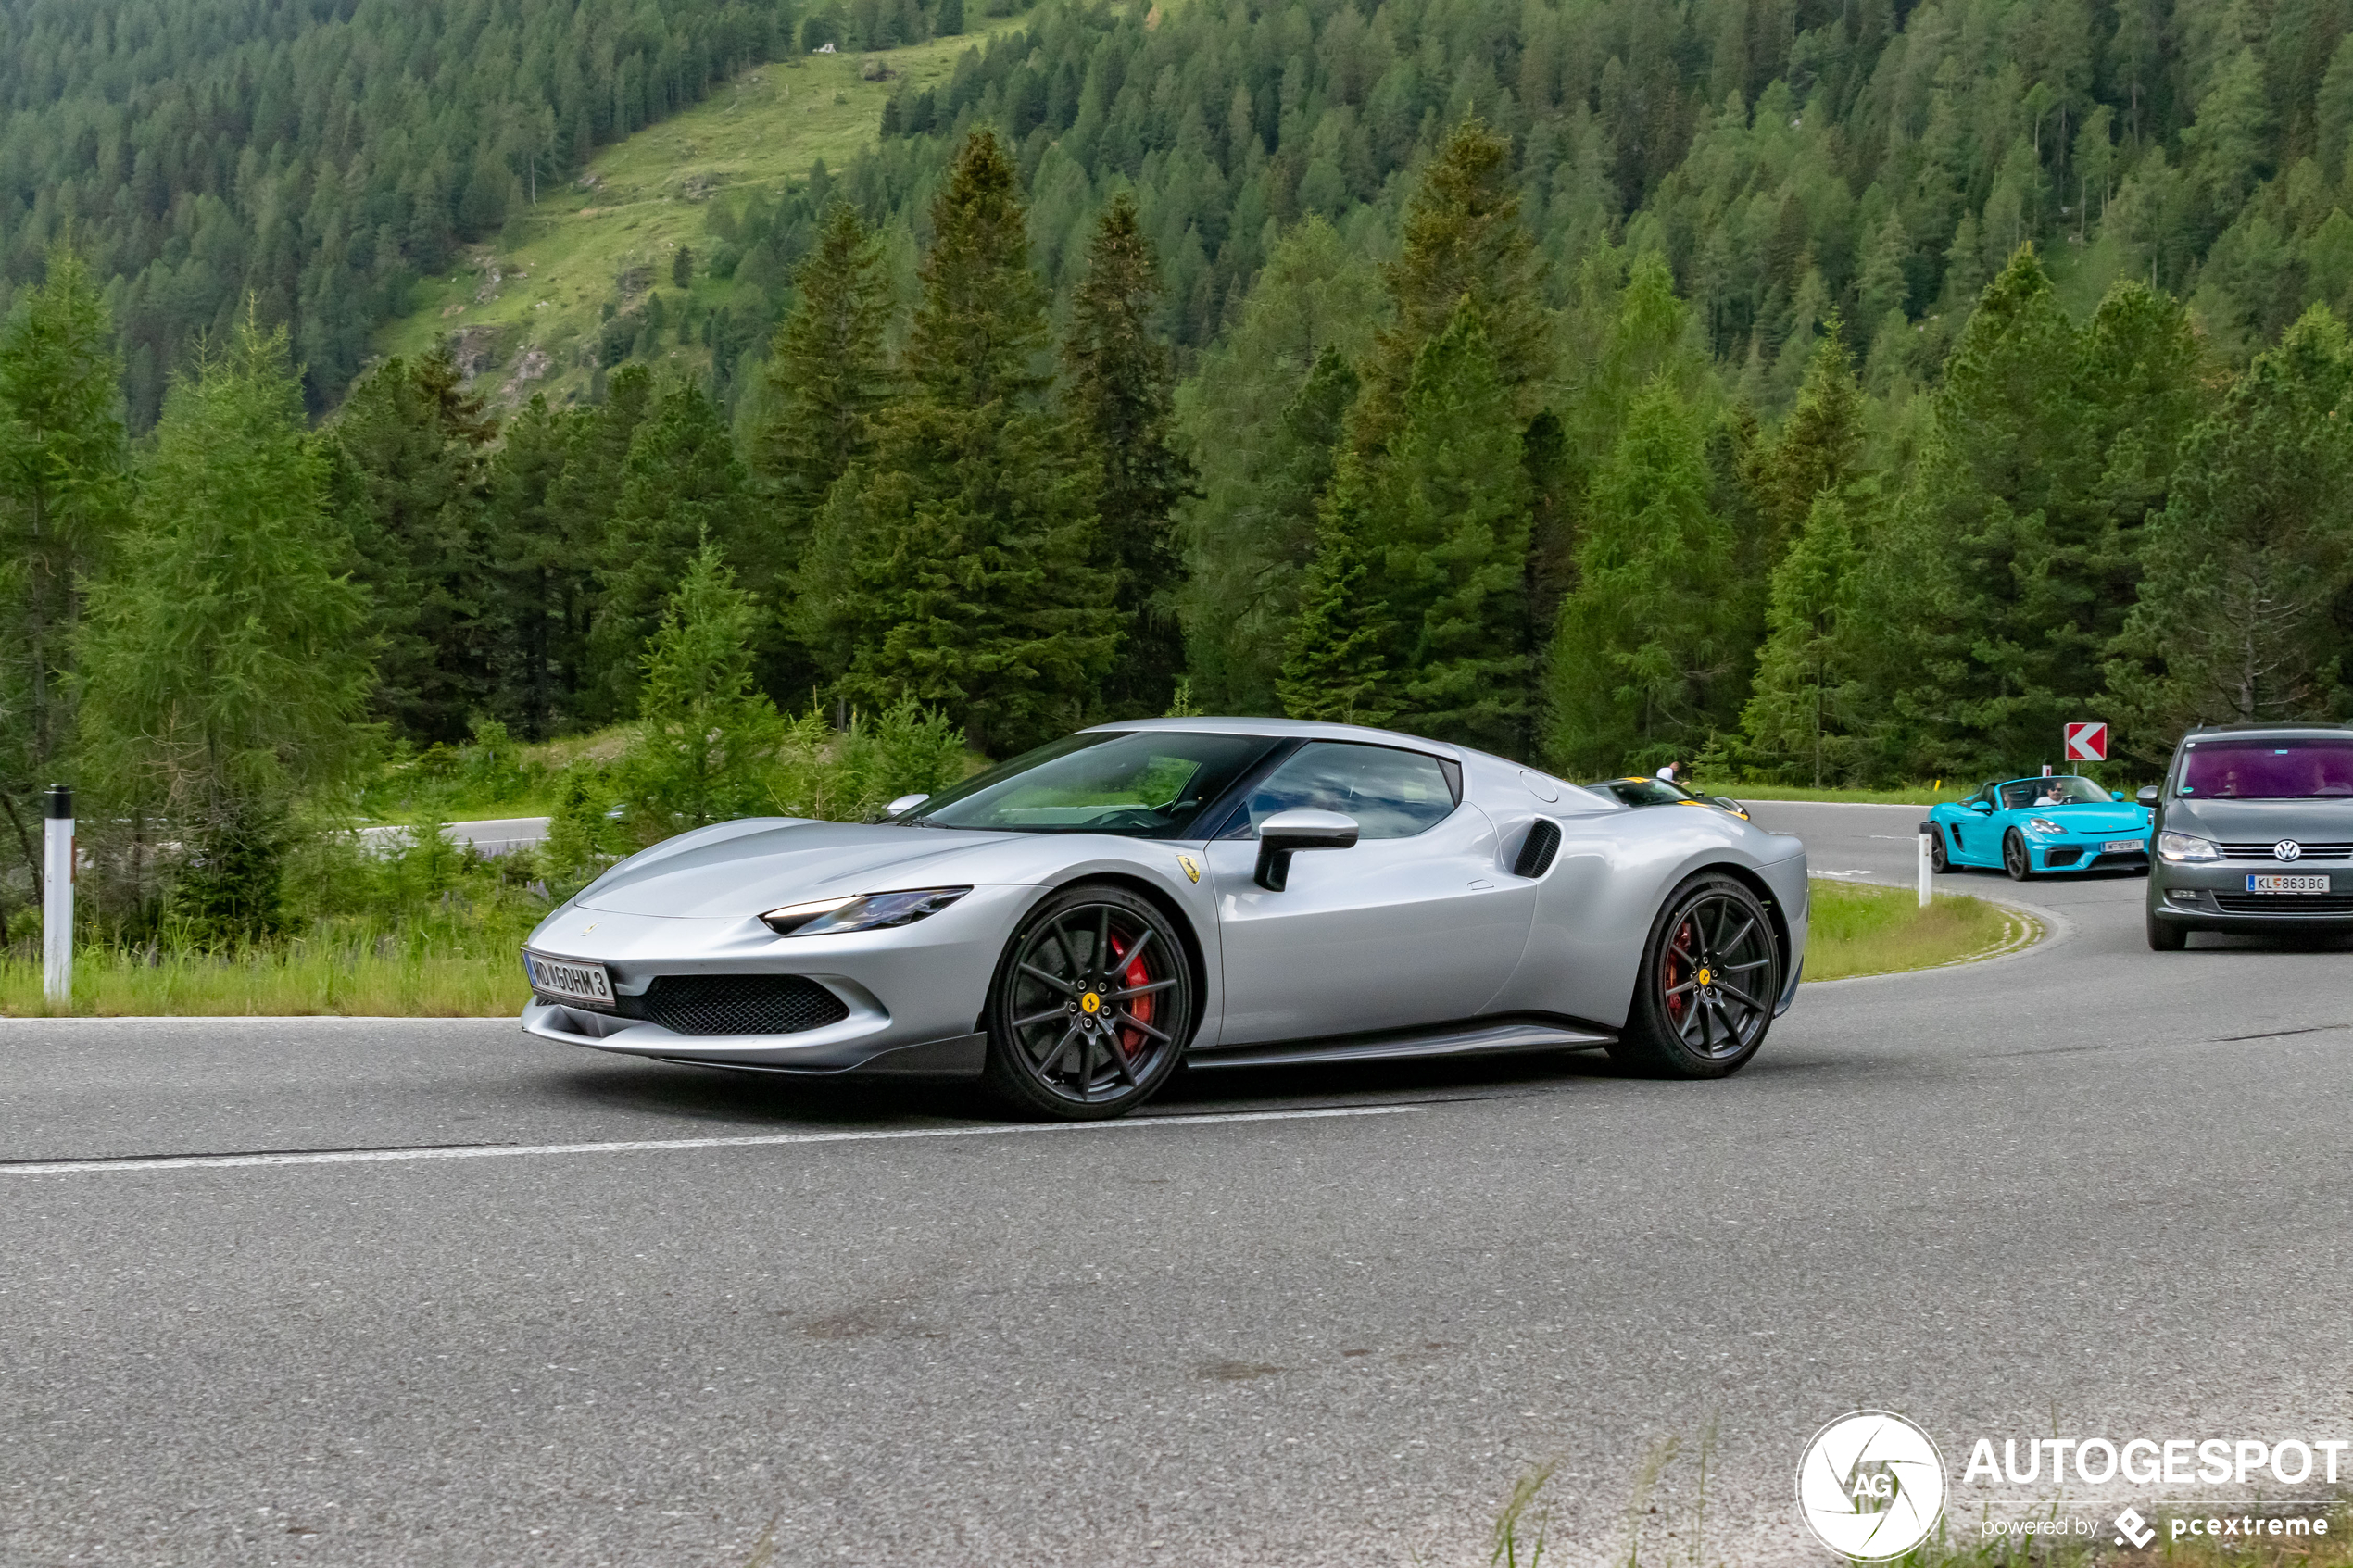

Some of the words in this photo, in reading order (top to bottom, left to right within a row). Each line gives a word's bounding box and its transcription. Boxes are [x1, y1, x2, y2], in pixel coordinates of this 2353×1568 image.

[2259, 878, 2272, 889] KL
[2282, 878, 2306, 889] 863
[2309, 878, 2324, 889] BG
[554, 964, 595, 996] GOHM
[594, 970, 607, 996] 3
